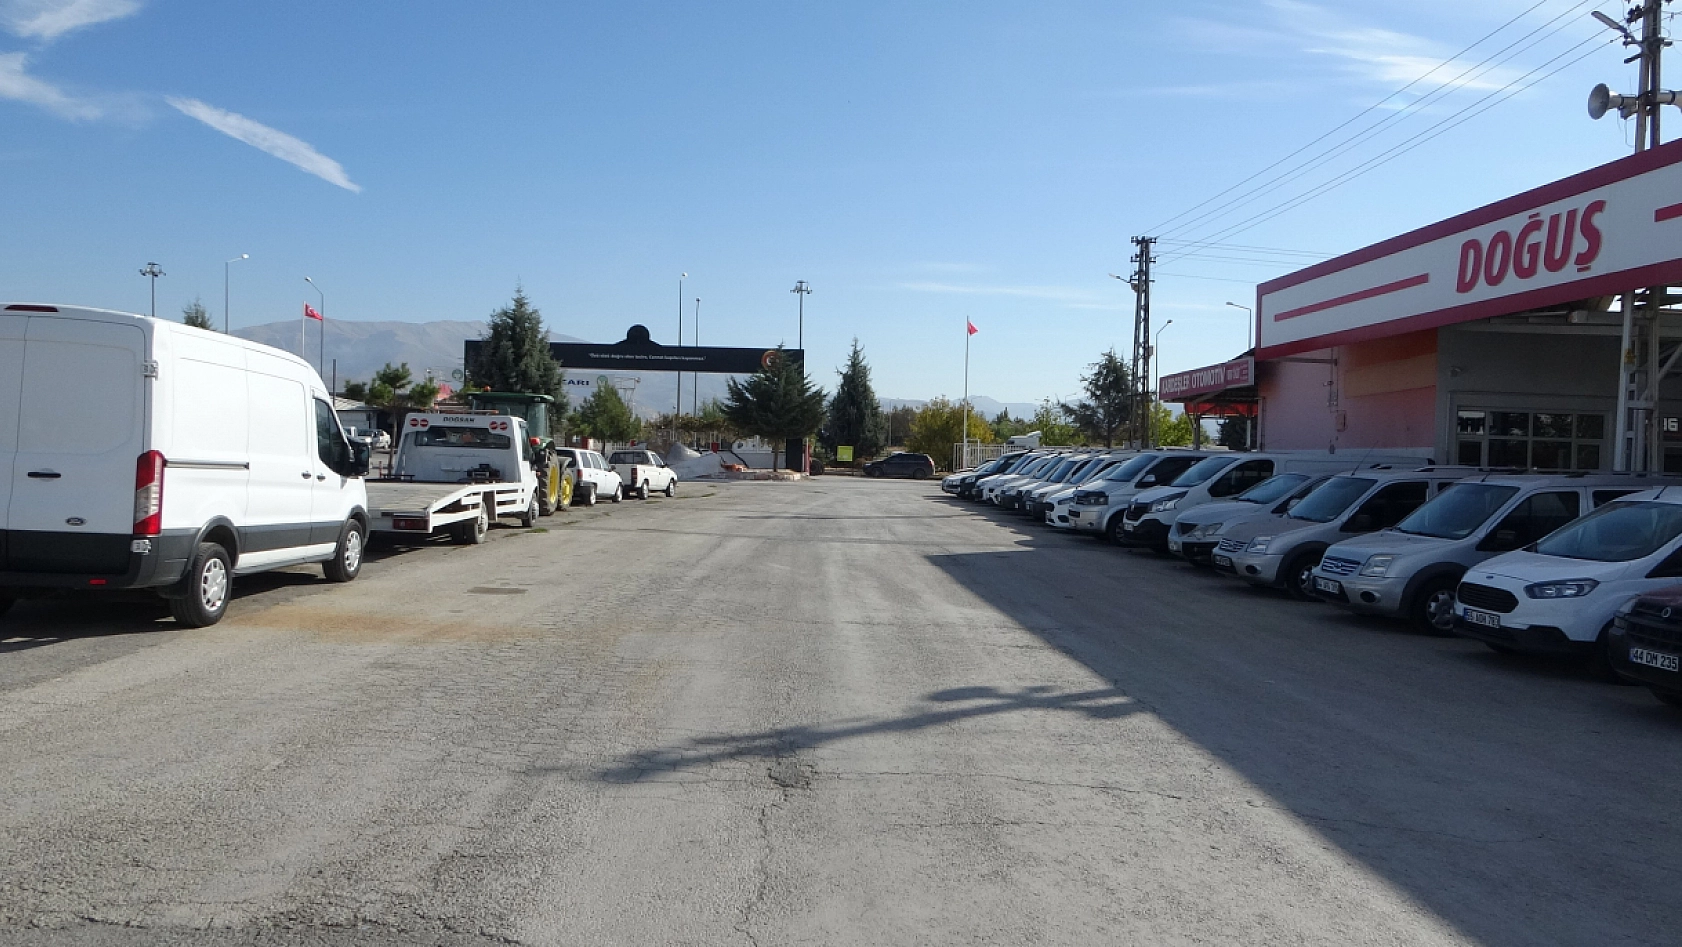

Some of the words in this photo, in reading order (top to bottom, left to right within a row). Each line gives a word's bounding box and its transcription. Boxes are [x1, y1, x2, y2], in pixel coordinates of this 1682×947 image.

[1456, 199, 1606, 294] DOĞUŞ
[1663, 417, 1679, 432] 16
[1633, 649, 1644, 662] 44
[1660, 655, 1678, 670] 235
